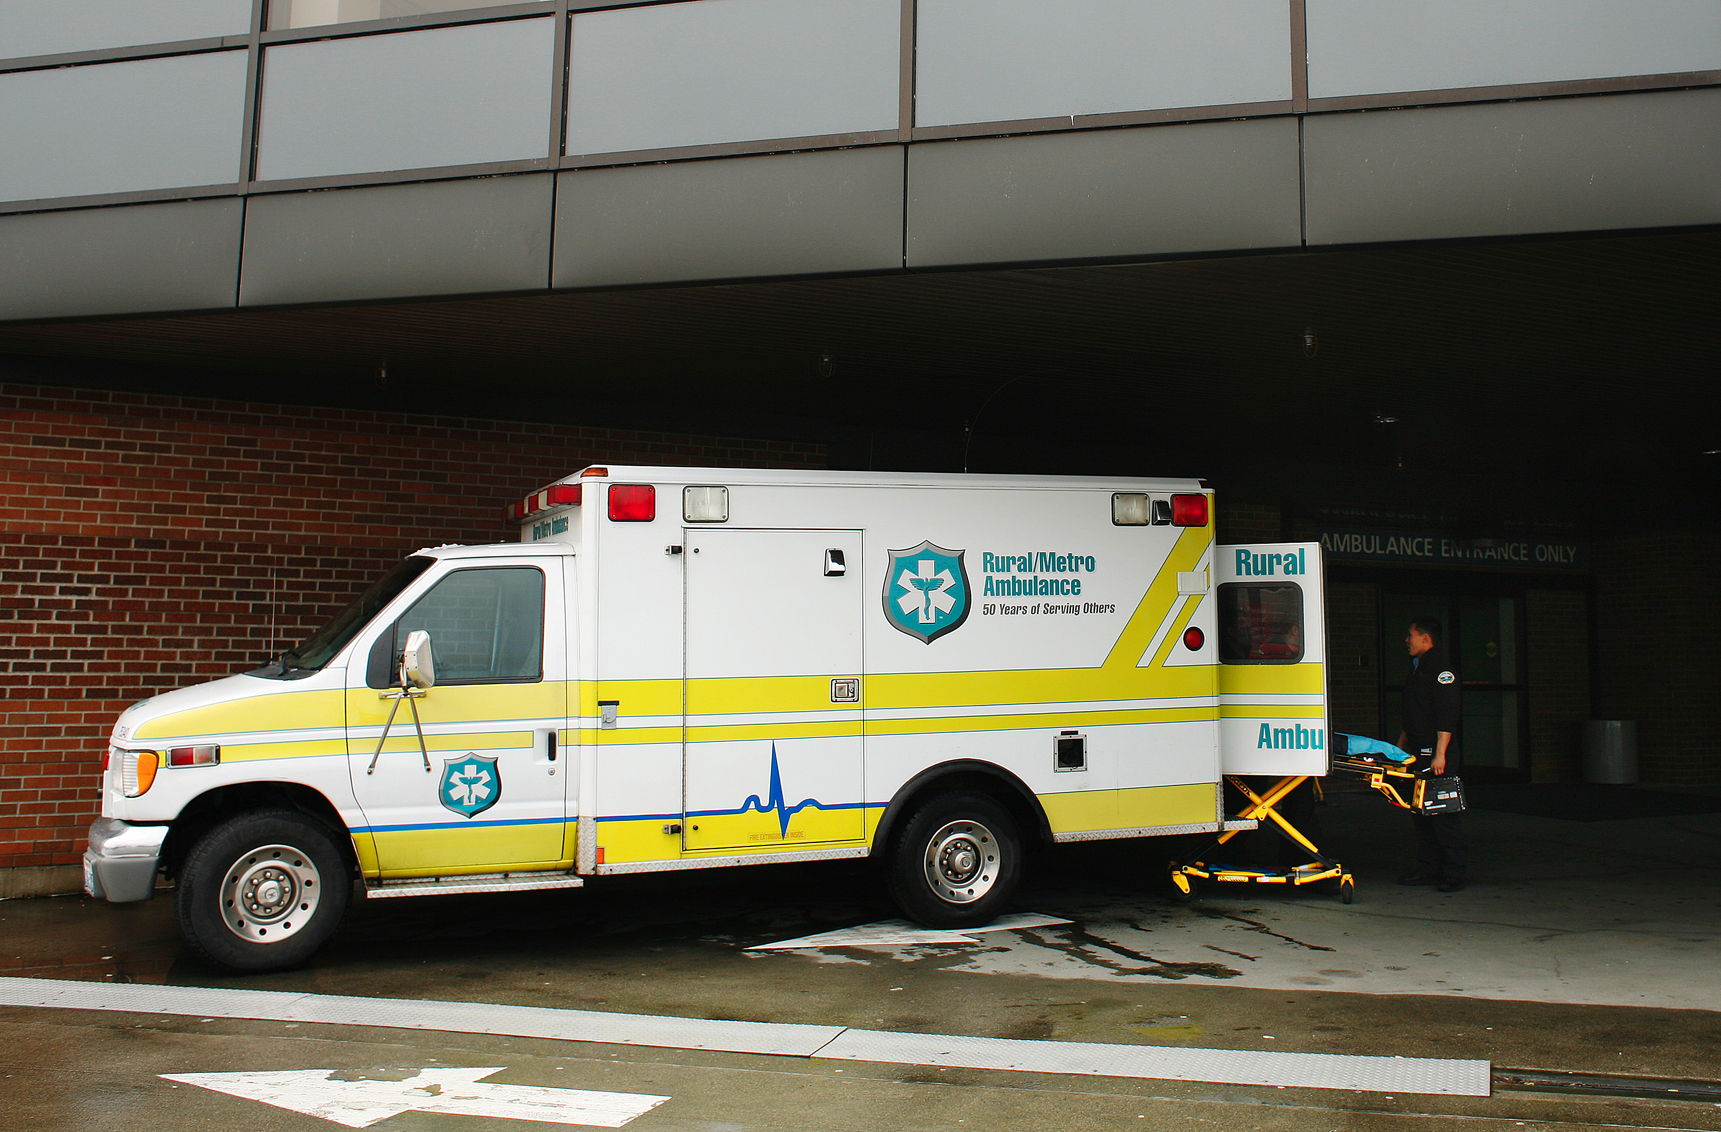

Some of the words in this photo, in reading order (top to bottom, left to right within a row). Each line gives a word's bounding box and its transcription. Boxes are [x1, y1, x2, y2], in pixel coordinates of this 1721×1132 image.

[1320, 532, 1433, 556] AMBULANCE
[1535, 544, 1577, 563] ONLY
[982, 551, 1096, 573] Rural/Metro
[1235, 547, 1306, 576] Rural
[983, 575, 1081, 597] Ambulance
[982, 603, 996, 616] 50
[999, 603, 1028, 616] Years
[1030, 603, 1041, 616] of
[1042, 602, 1080, 616] Serving
[1083, 602, 1116, 614] Others
[1257, 722, 1324, 750] Ambu
[760, 832, 790, 841] EXTINGUISER
